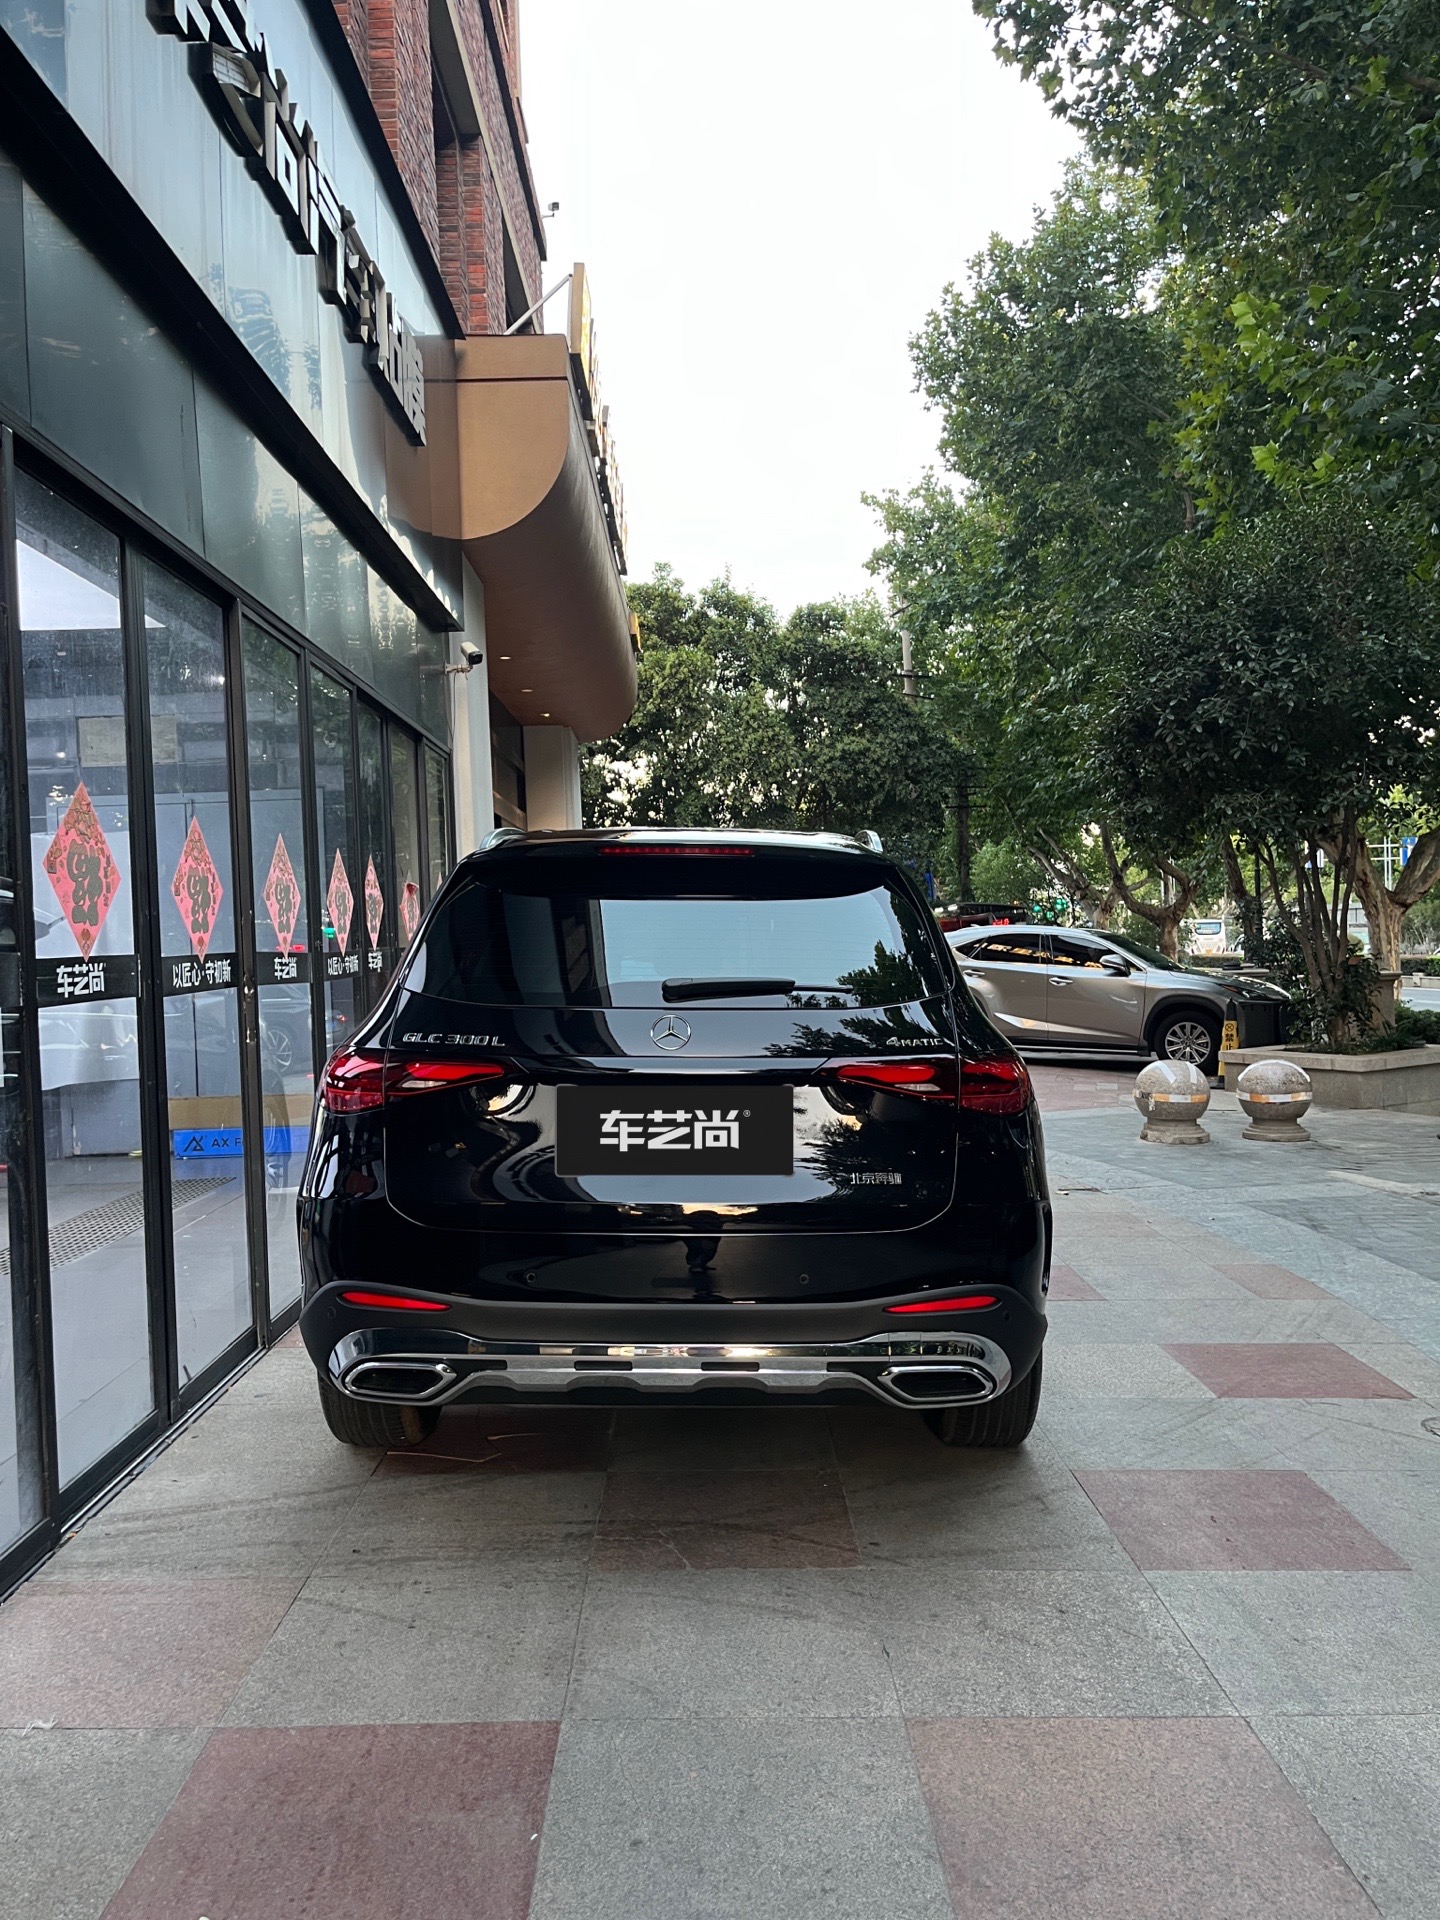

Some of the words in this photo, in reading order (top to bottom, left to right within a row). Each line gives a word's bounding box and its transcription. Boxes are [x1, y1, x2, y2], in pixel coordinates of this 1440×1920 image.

[56, 962, 106, 998] 车艺尚
[402, 1032, 443, 1044] GLC
[886, 1036, 944, 1047] 4MATIC
[849, 1172, 902, 1185] 北京奔驰
